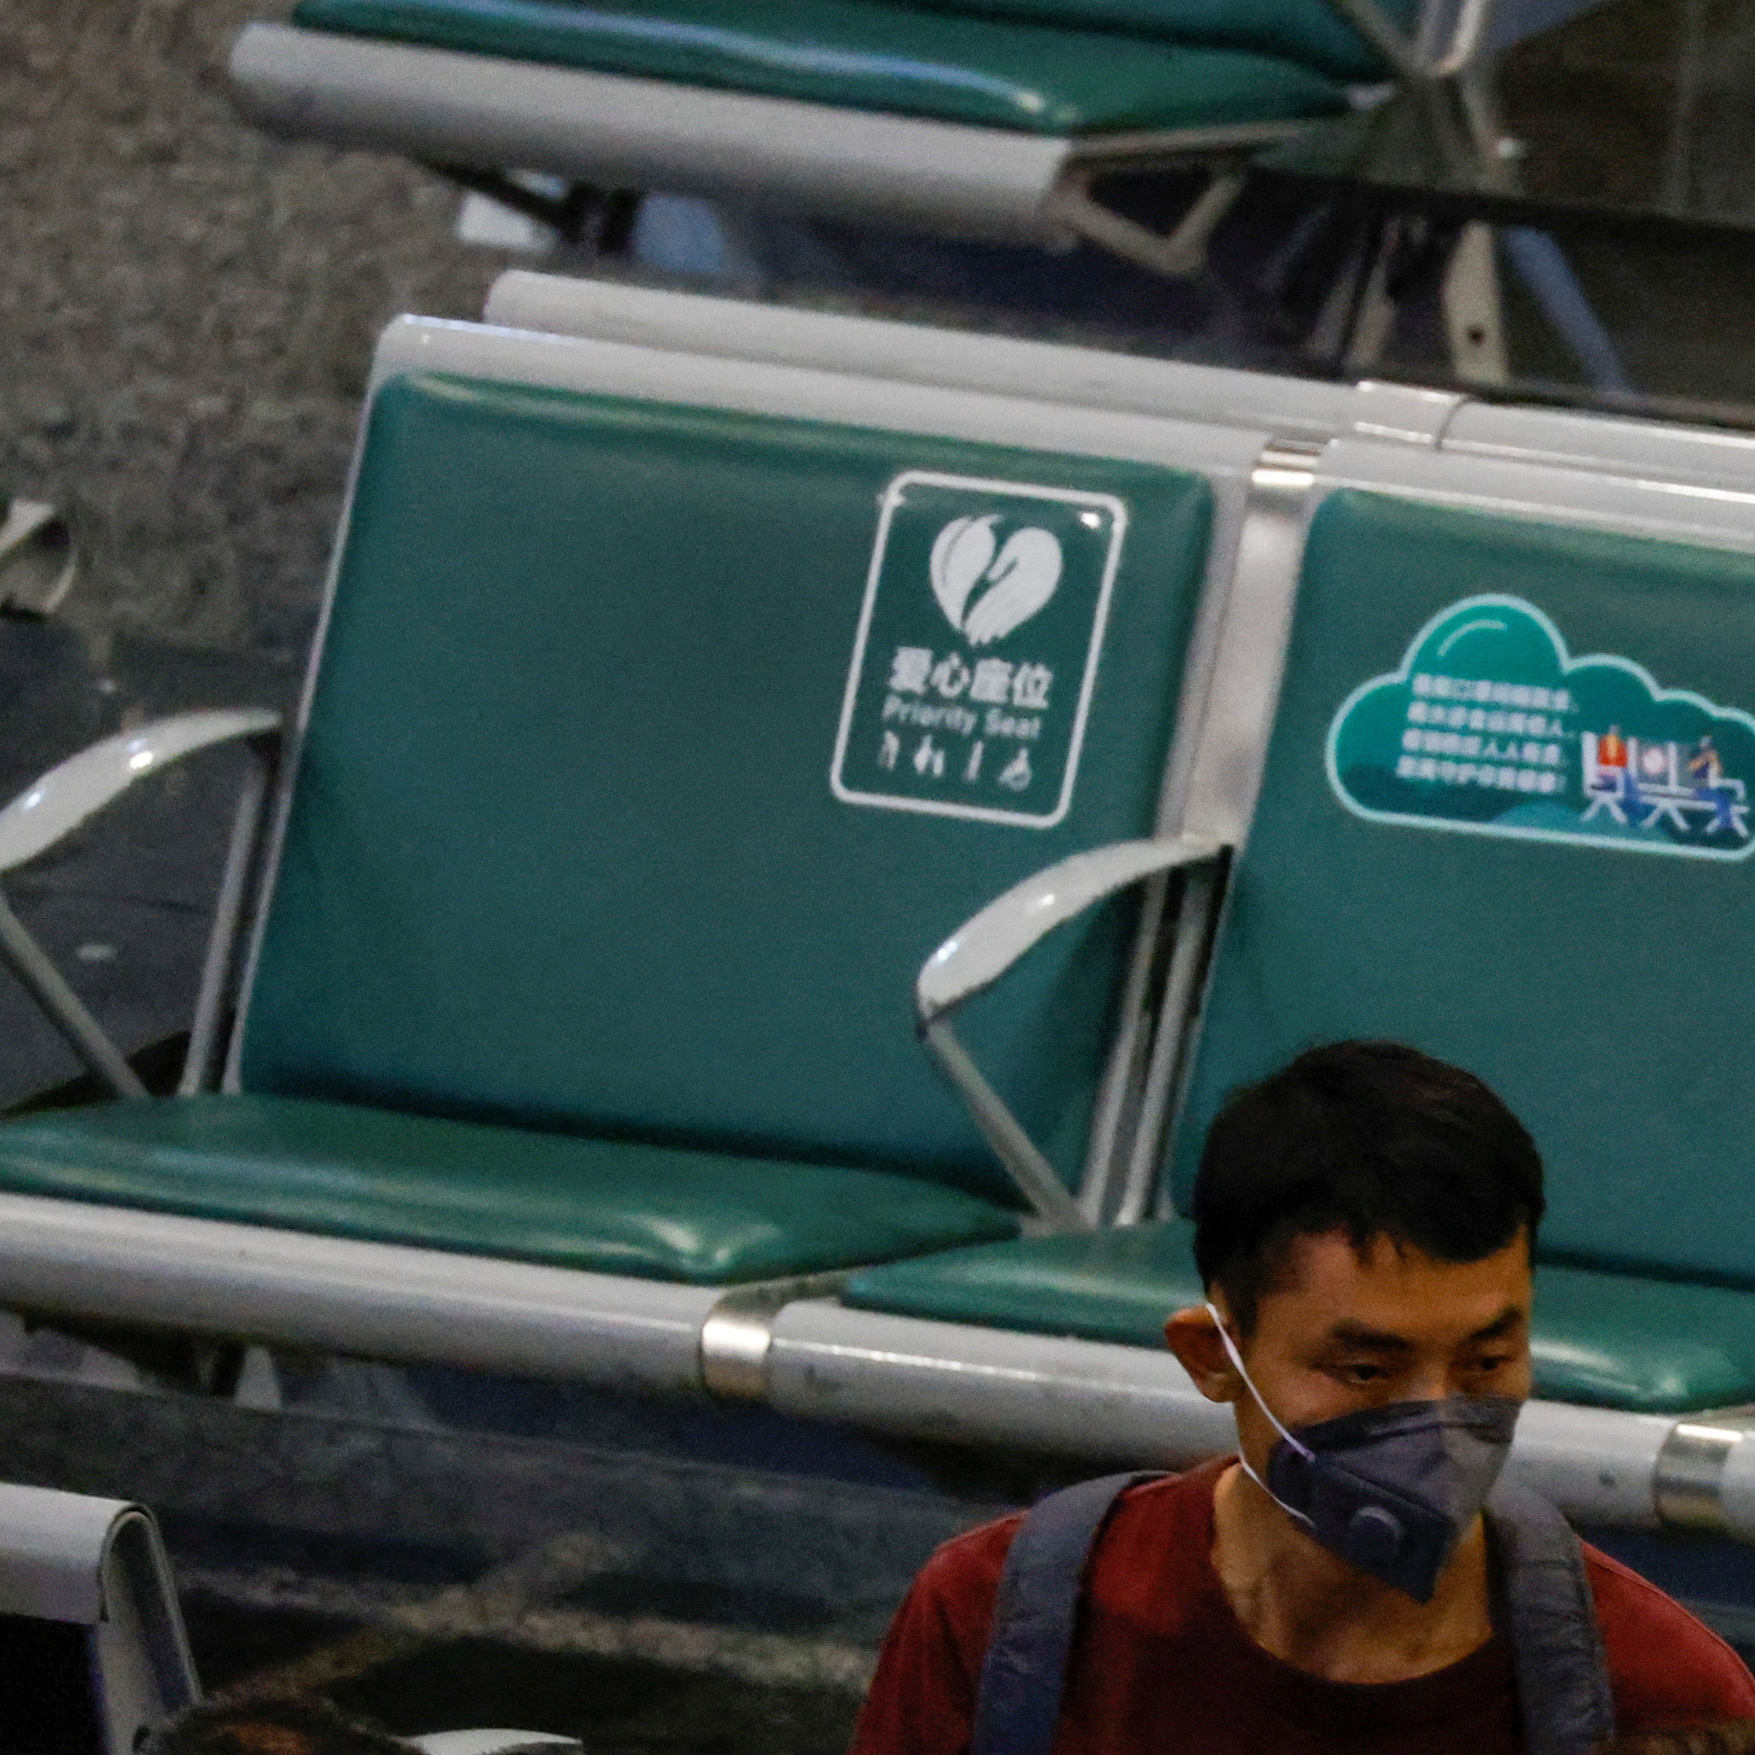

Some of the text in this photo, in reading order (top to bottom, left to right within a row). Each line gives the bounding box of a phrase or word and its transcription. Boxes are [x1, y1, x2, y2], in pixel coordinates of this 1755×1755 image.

[888, 645, 1054, 710] 爱心座位
[881, 694, 1042, 741] Priority Seat
